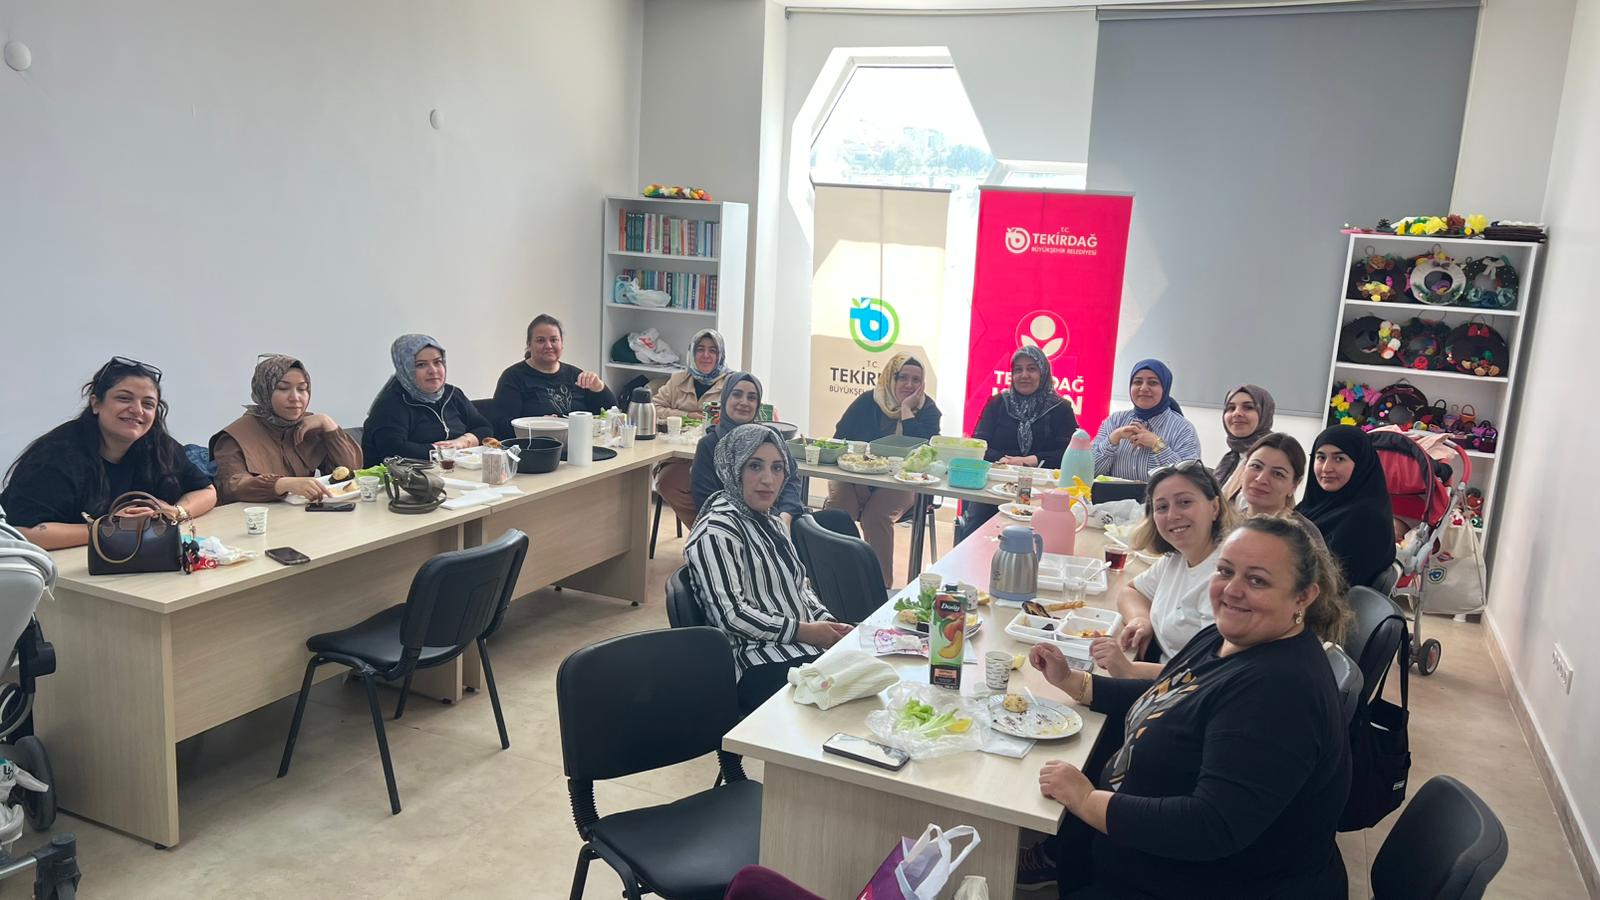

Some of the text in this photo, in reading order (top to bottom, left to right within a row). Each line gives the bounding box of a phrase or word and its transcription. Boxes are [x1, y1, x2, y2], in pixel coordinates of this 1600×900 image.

[1032, 231, 1098, 248] TEKİRDAĞ
[829, 366, 882, 386] TEKİR
[993, 370, 1084, 393] TEDAĞ
[829, 384, 865, 397] BÜYÜKŞE
